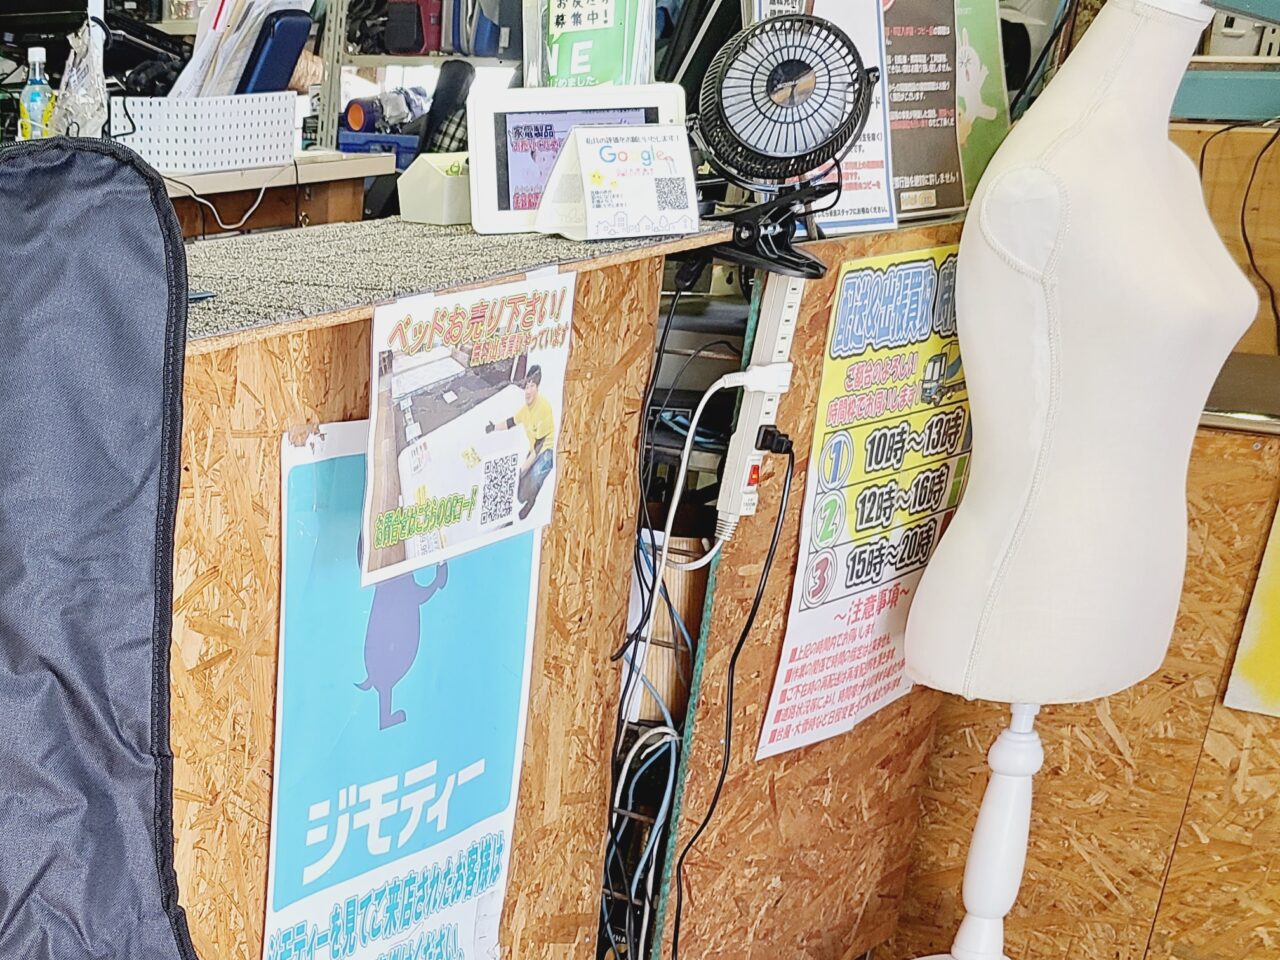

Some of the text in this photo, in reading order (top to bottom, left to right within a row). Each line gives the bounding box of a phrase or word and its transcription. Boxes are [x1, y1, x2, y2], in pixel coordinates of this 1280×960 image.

[599, 145, 665, 167] Gogle
[302, 758, 485, 886] ジモティー
